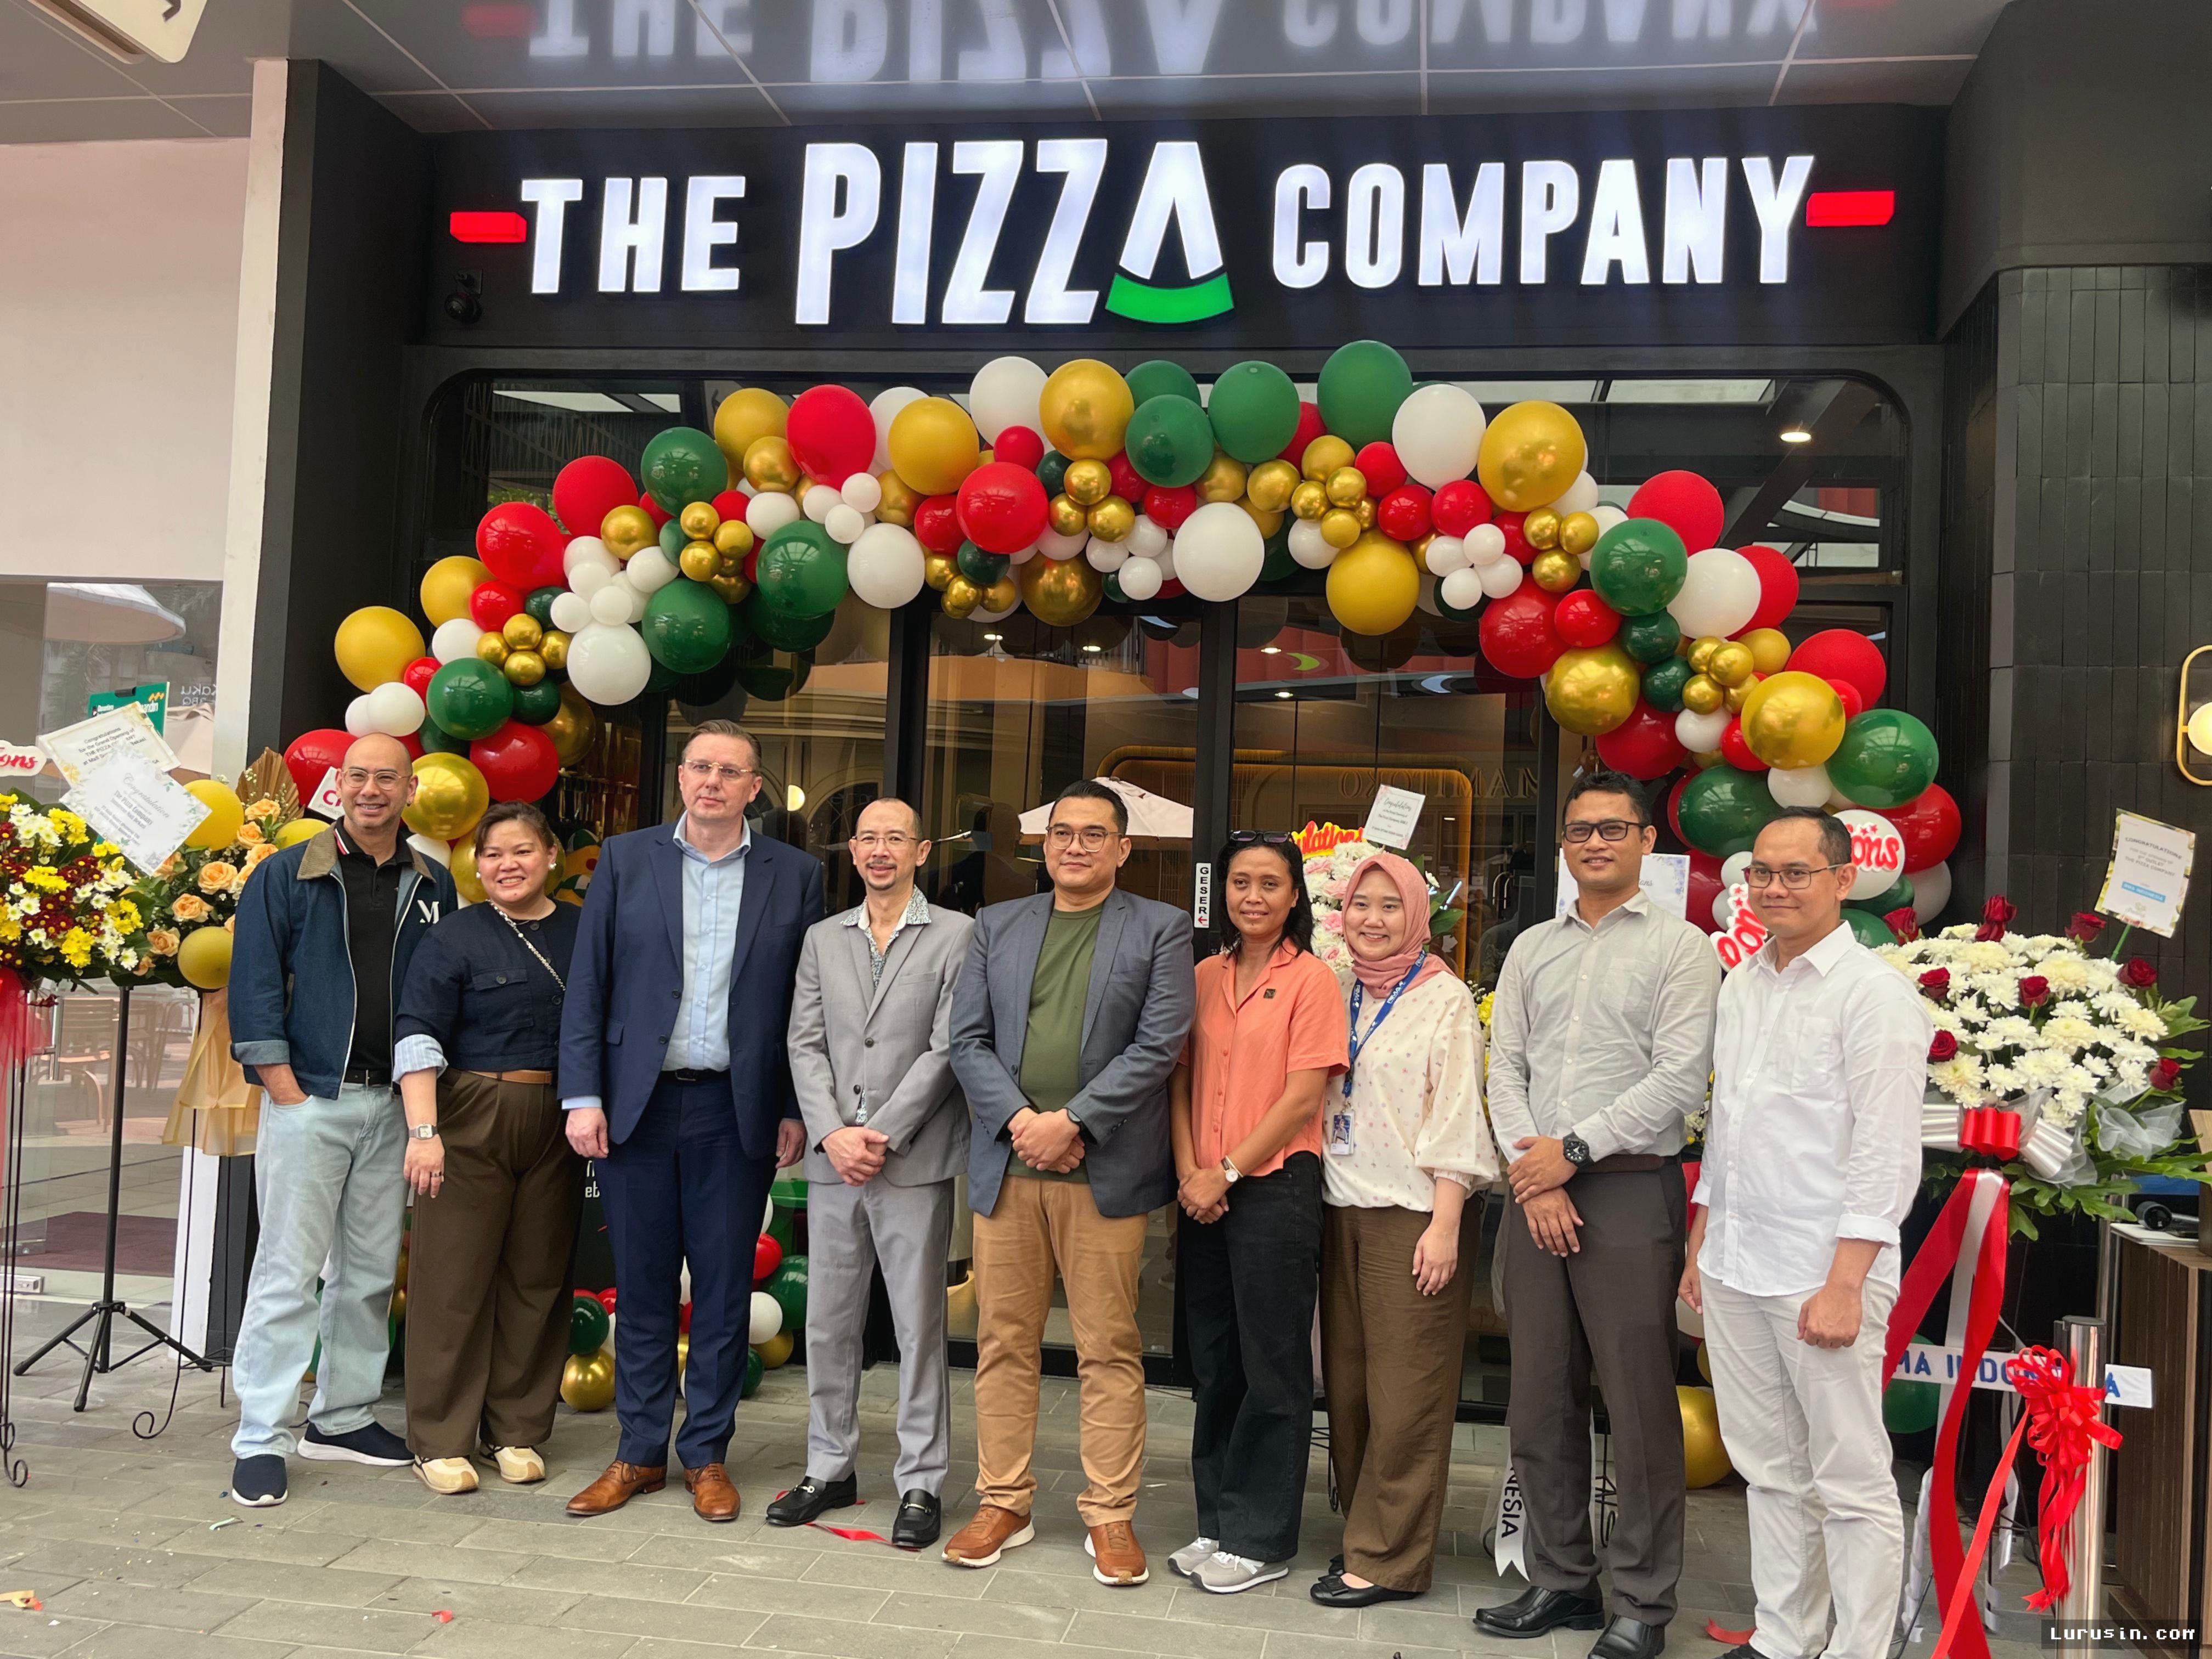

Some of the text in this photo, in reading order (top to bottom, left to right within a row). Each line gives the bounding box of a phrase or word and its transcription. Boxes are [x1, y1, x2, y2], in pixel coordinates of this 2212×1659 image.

[521, 139, 1814, 325] THE PIZZA COMPANY
[95, 738, 109, 748] Grand
[109, 730, 129, 742] Opening
[1198, 867, 1209, 915] GESER
